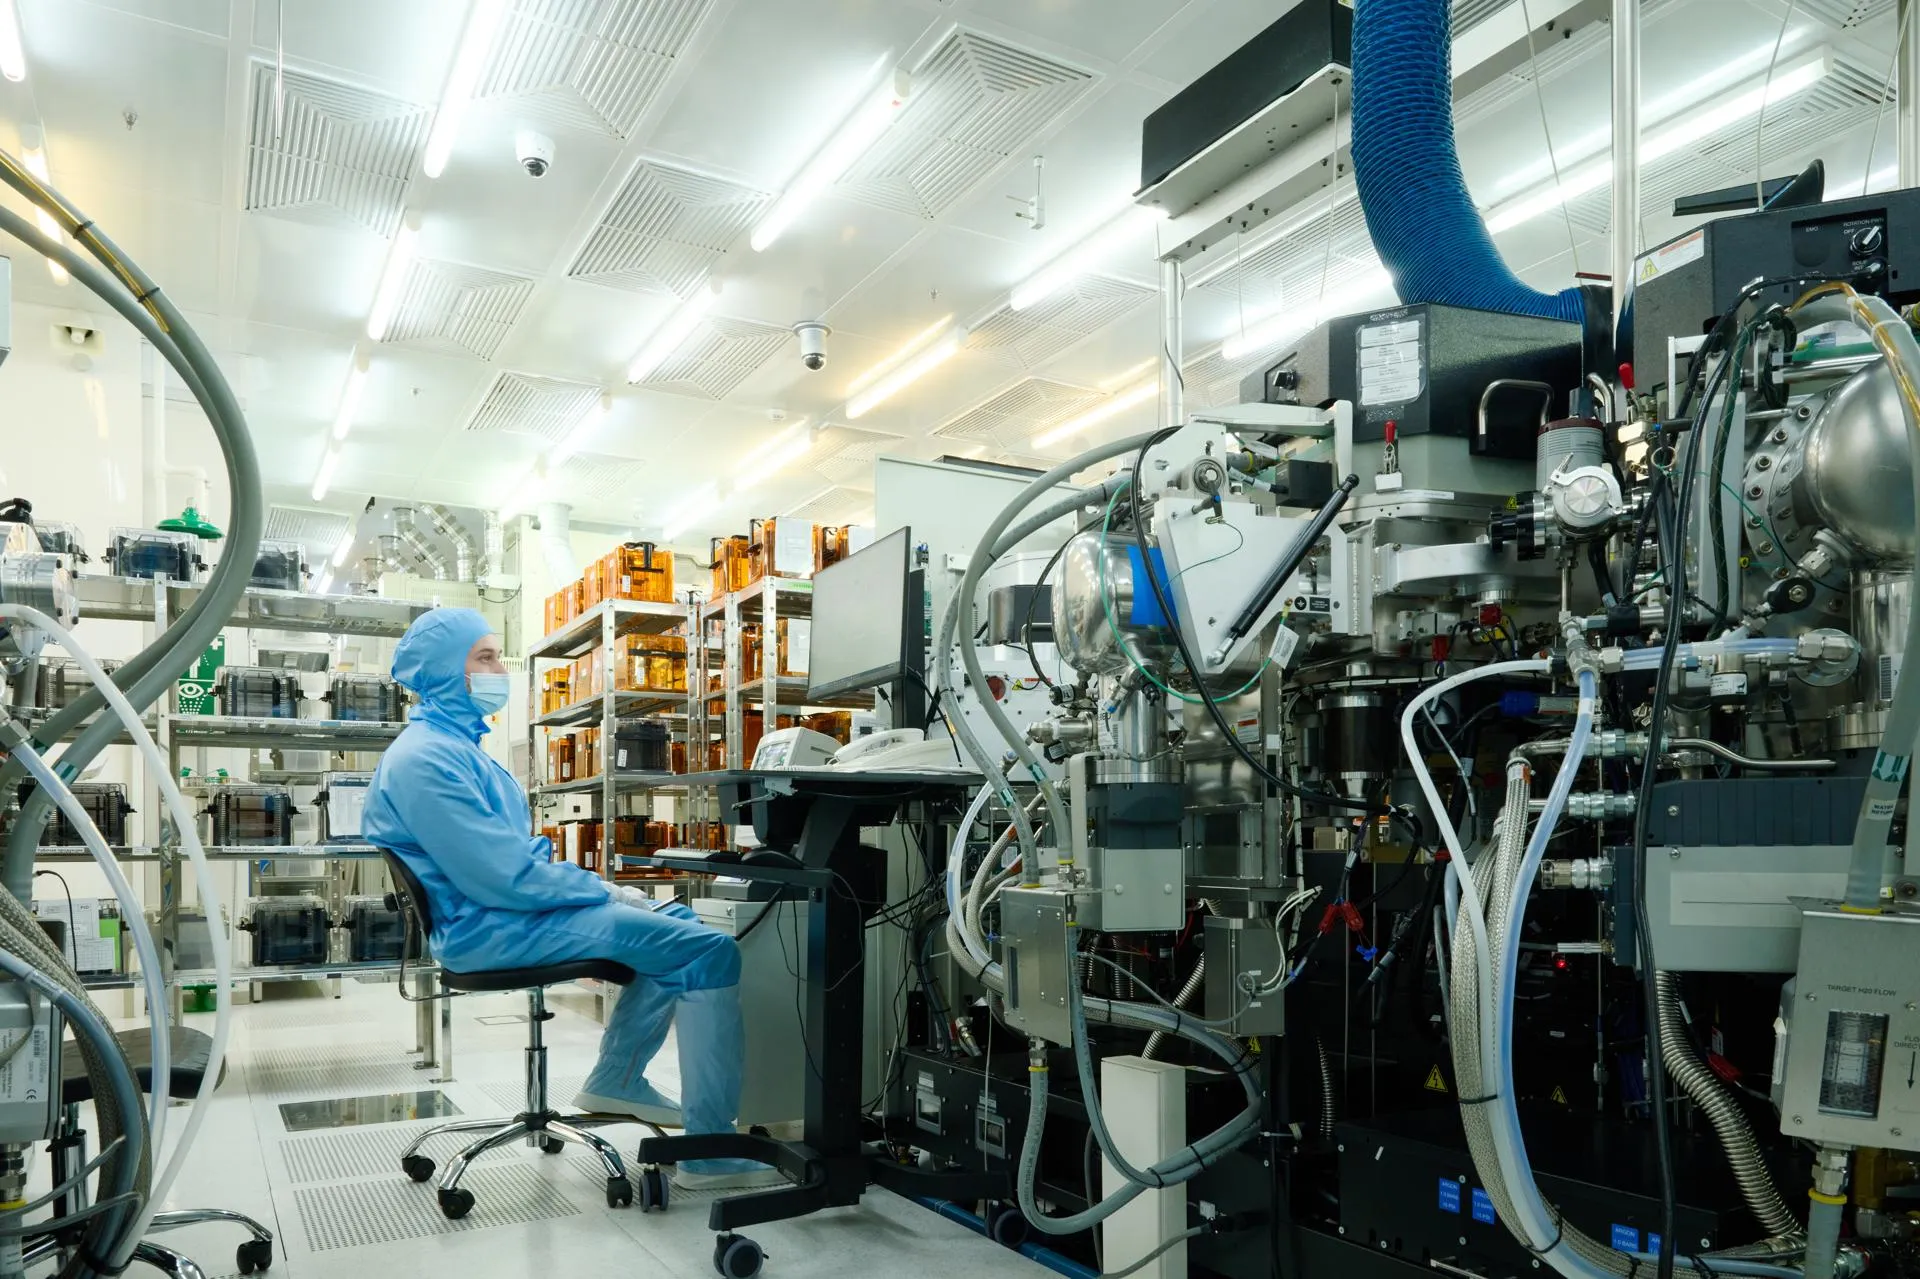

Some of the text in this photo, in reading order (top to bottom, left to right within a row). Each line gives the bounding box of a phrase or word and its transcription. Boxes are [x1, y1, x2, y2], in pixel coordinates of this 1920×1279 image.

[1827, 984, 1857, 993] TARGET
[1874, 988, 1897, 997] FLOW
[1904, 1034, 1920, 1043] FLO
